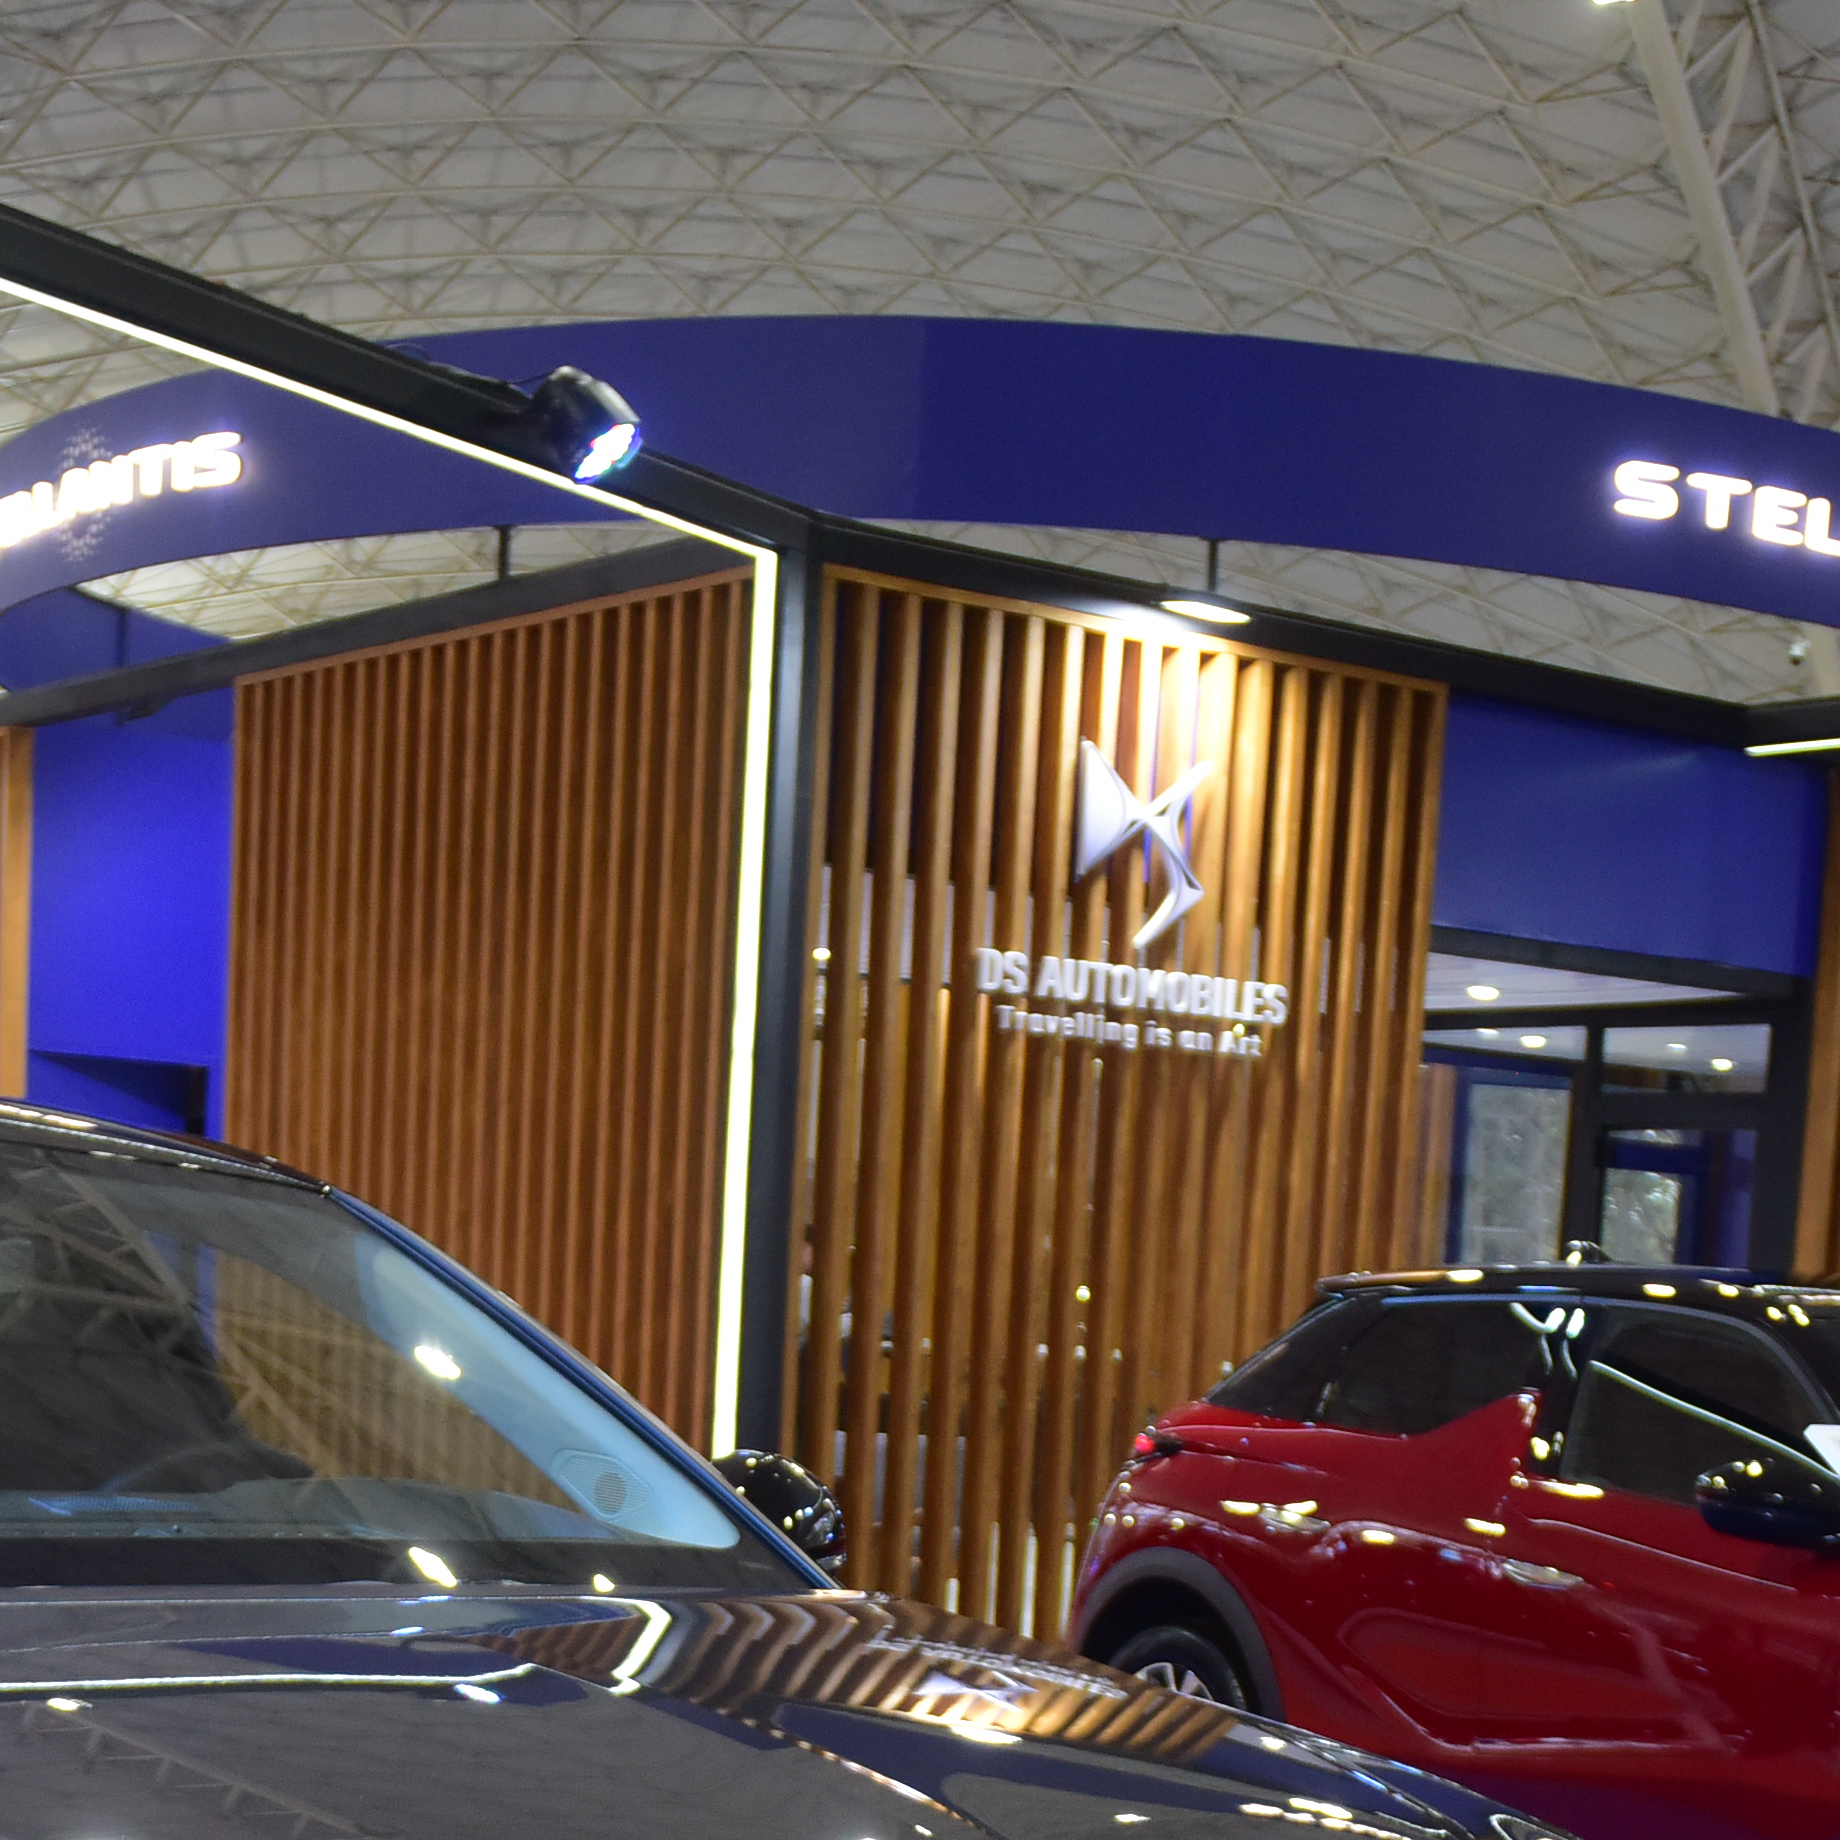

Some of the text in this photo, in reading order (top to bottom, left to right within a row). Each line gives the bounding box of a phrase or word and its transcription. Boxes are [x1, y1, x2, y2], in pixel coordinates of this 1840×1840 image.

[977, 948, 1288, 1025] DS AUTOMOBILES
[996, 1005, 1139, 1050] Travelling
[1144, 1020, 1172, 1048] is
[1178, 1029, 1214, 1052] an
